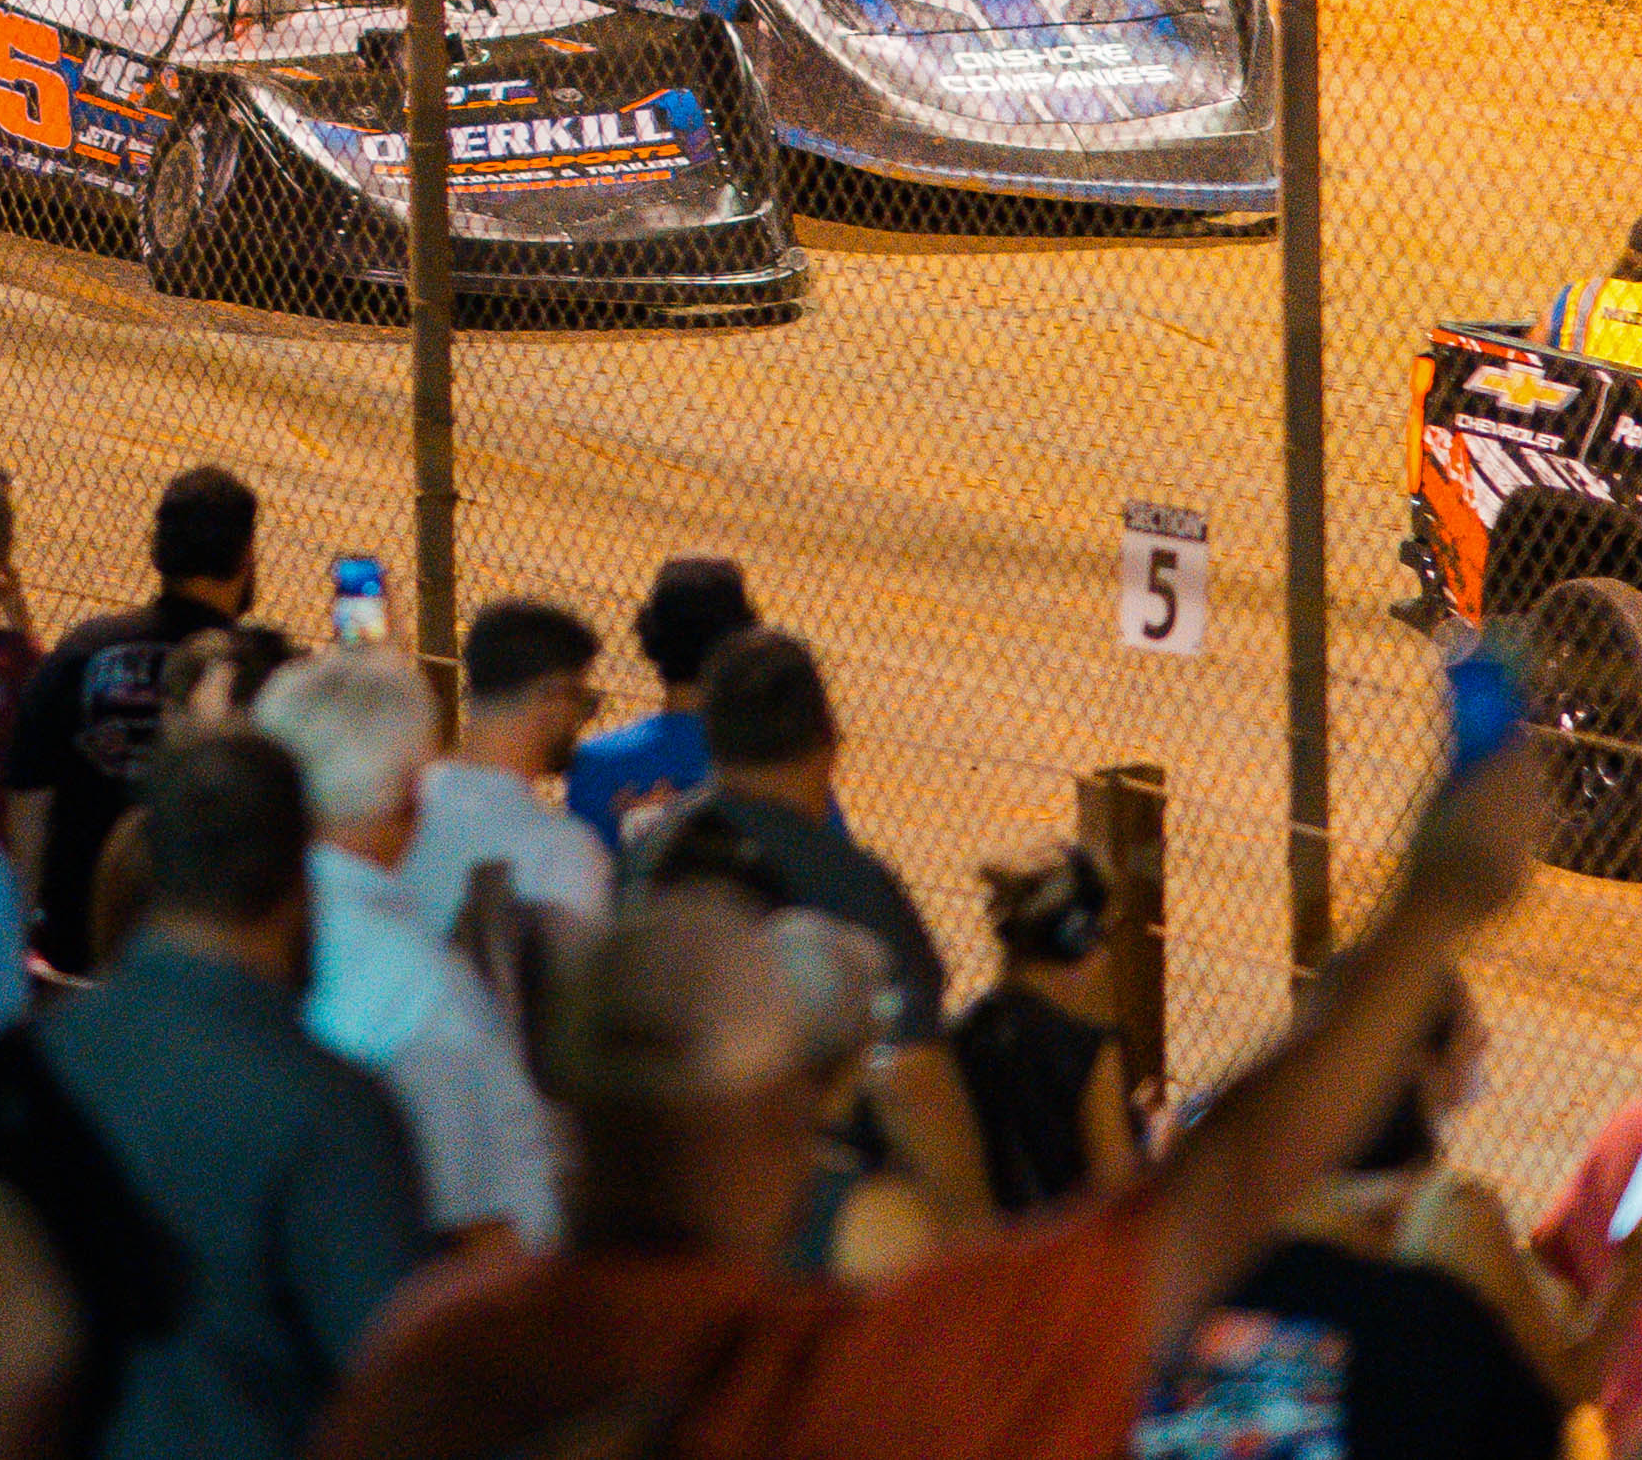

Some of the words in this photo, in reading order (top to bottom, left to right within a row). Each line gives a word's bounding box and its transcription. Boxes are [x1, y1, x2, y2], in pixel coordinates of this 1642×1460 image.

[952, 43, 1133, 70] ONSHORE
[938, 64, 1176, 94] COMPANIES
[364, 108, 674, 163] OERKILL
[1455, 413, 1565, 451] CHEVROLET
[1143, 547, 1178, 640] 5
